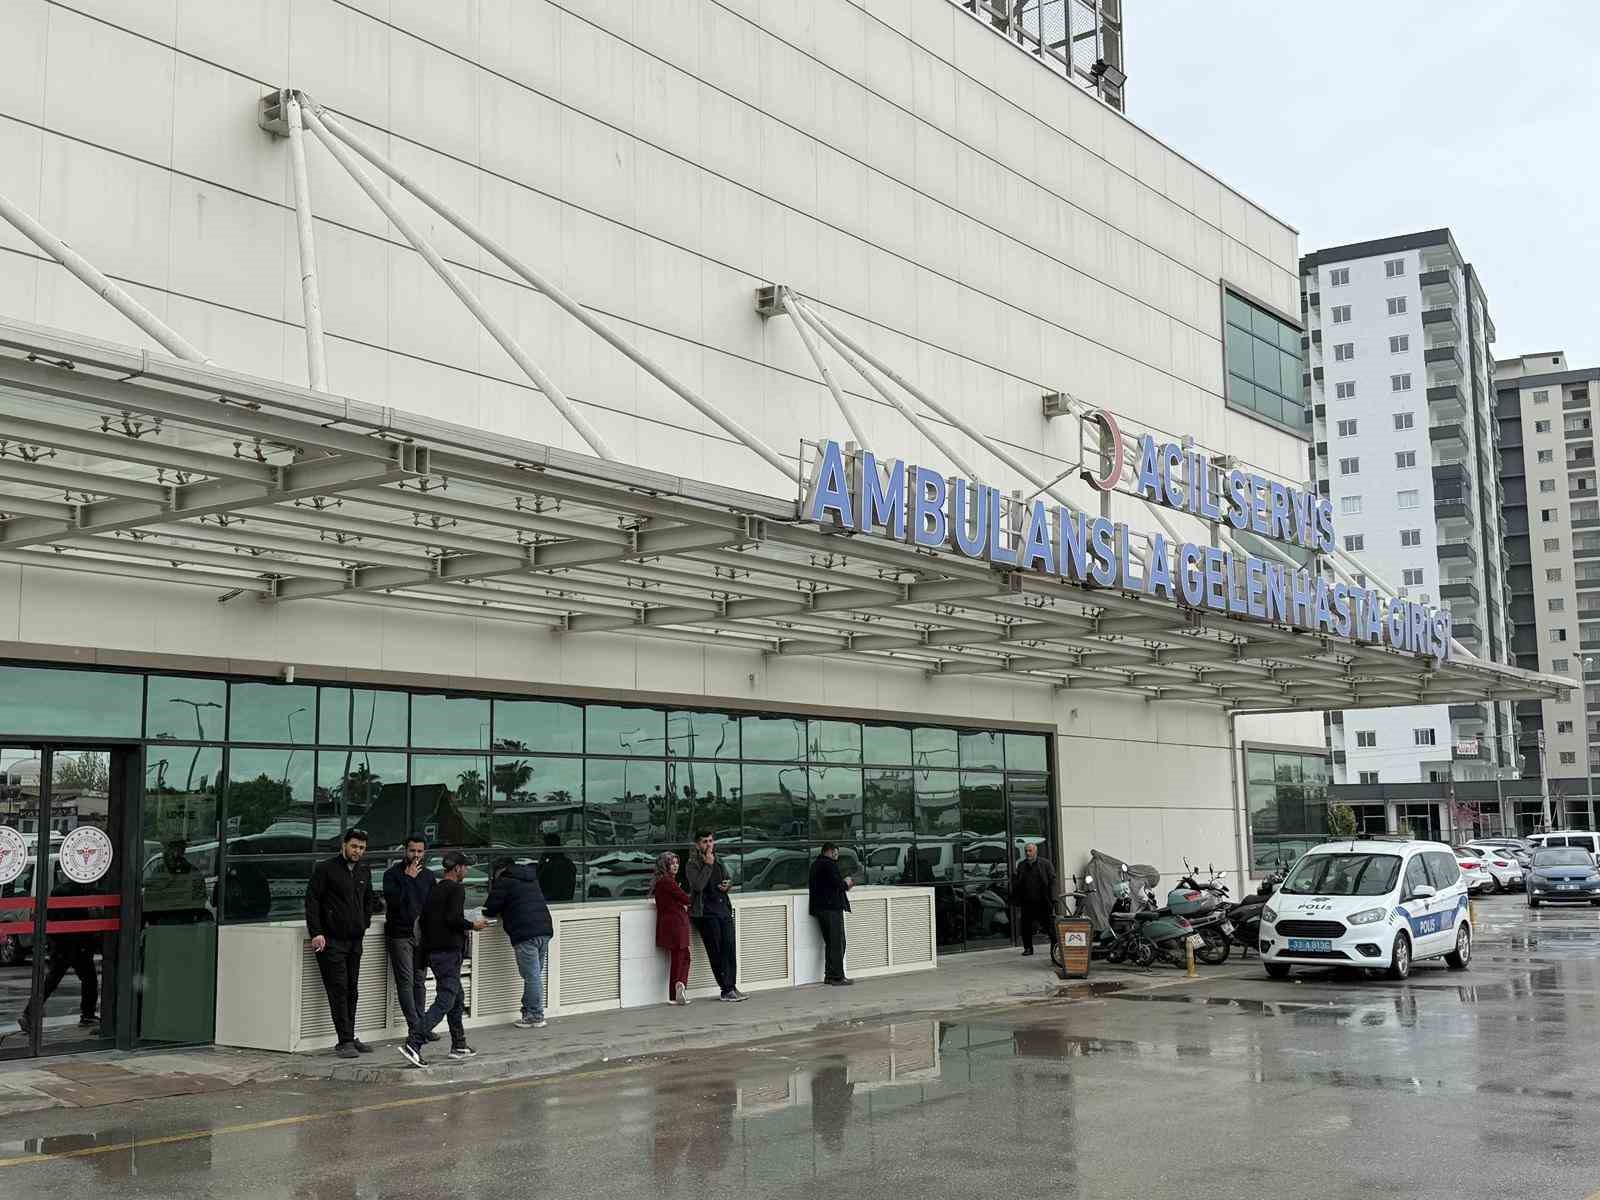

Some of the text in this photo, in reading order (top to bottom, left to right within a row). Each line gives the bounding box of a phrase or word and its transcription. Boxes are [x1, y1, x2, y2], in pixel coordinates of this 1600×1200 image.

[811, 439, 1175, 599] AMBULANSLA
[1181, 543, 1286, 621] GELEN
[1291, 568, 1383, 642] HASTA
[1138, 433, 1336, 553] ACİL SERVİS
